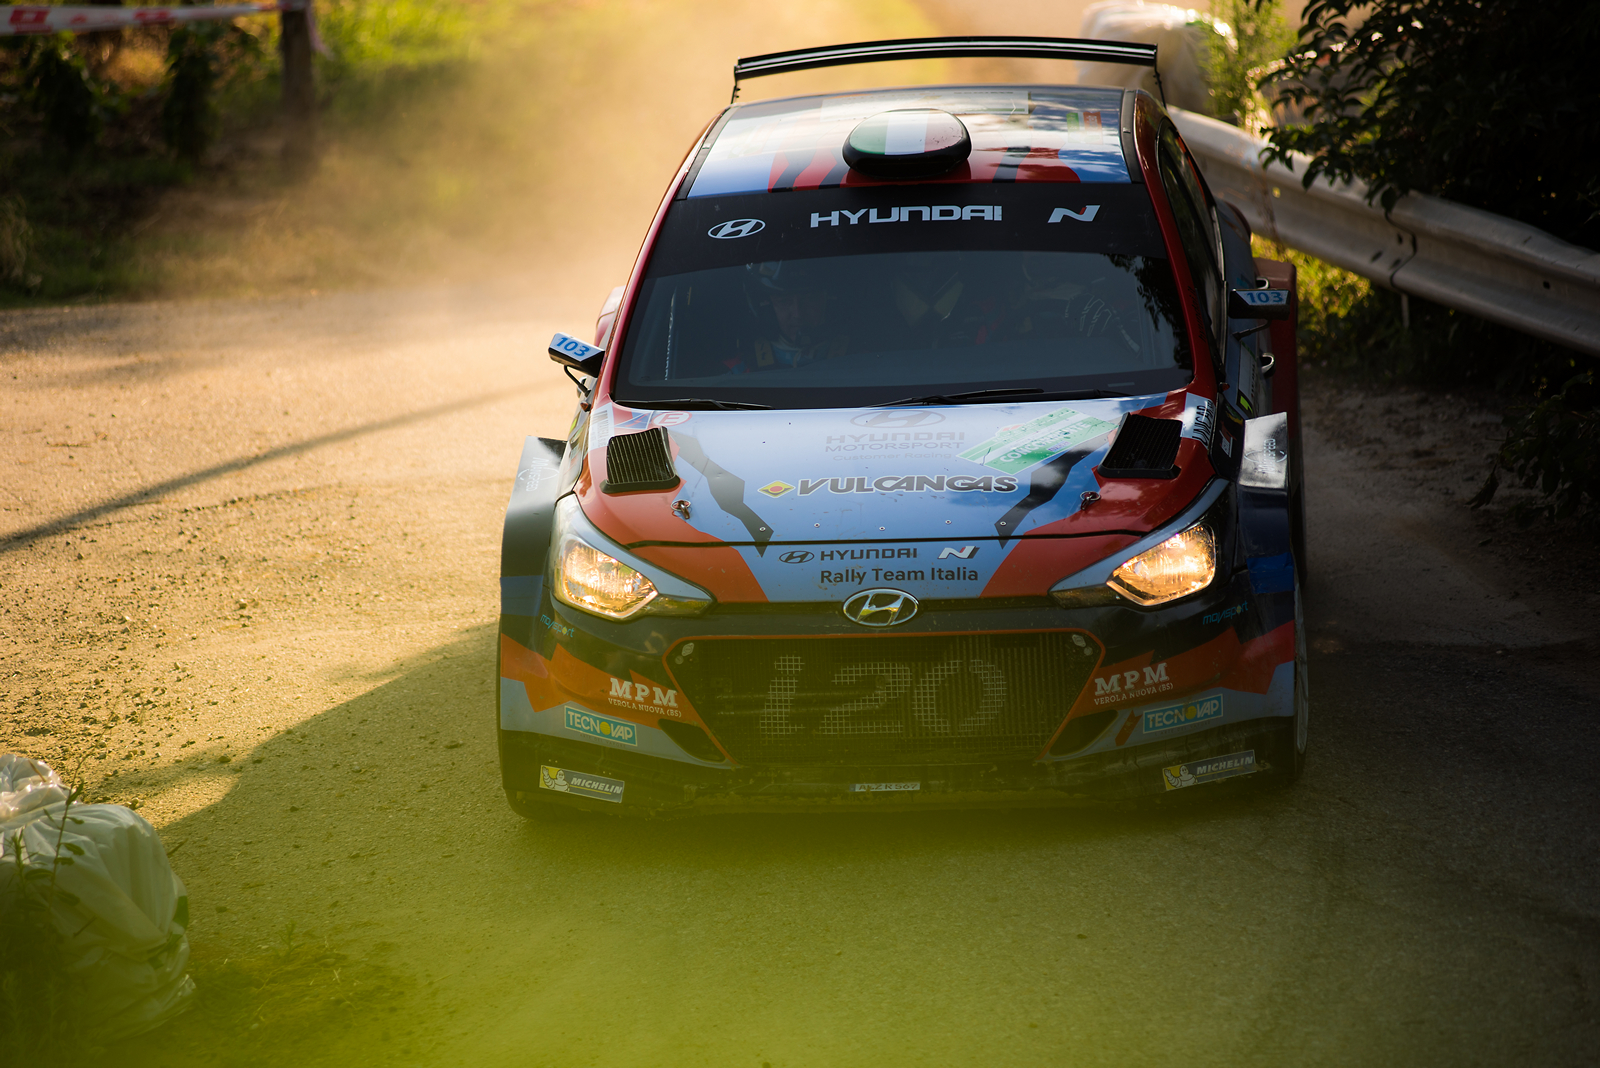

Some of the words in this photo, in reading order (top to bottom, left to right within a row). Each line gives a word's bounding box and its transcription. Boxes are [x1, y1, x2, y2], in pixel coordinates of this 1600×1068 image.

[810, 205, 1002, 228] HYUNDAI
[1246, 291, 1284, 304] 103
[556, 337, 590, 357] 103
[825, 441, 965, 453] MOTORSPORT
[826, 431, 965, 445] HYUNDAI
[833, 453, 900, 462] Customer
[903, 452, 952, 461] Racing
[797, 475, 1019, 496] VULCANGAS
[821, 548, 918, 561] HYUNDAI
[821, 569, 867, 585] Rally
[872, 567, 925, 582] Team
[931, 566, 979, 581] Italia
[1094, 662, 1170, 696] MPM
[609, 677, 679, 708] MPM
[1129, 687, 1158, 699] NUOVA
[1158, 682, 1174, 692] (BS)
[638, 703, 665, 716] NUOVA
[666, 709, 682, 718] (BS)
[1147, 699, 1220, 728] TECNOVAP
[567, 711, 634, 741] TECNOVAP
[1196, 756, 1254, 775] MICHELIN
[570, 777, 623, 794] MICHELIN
